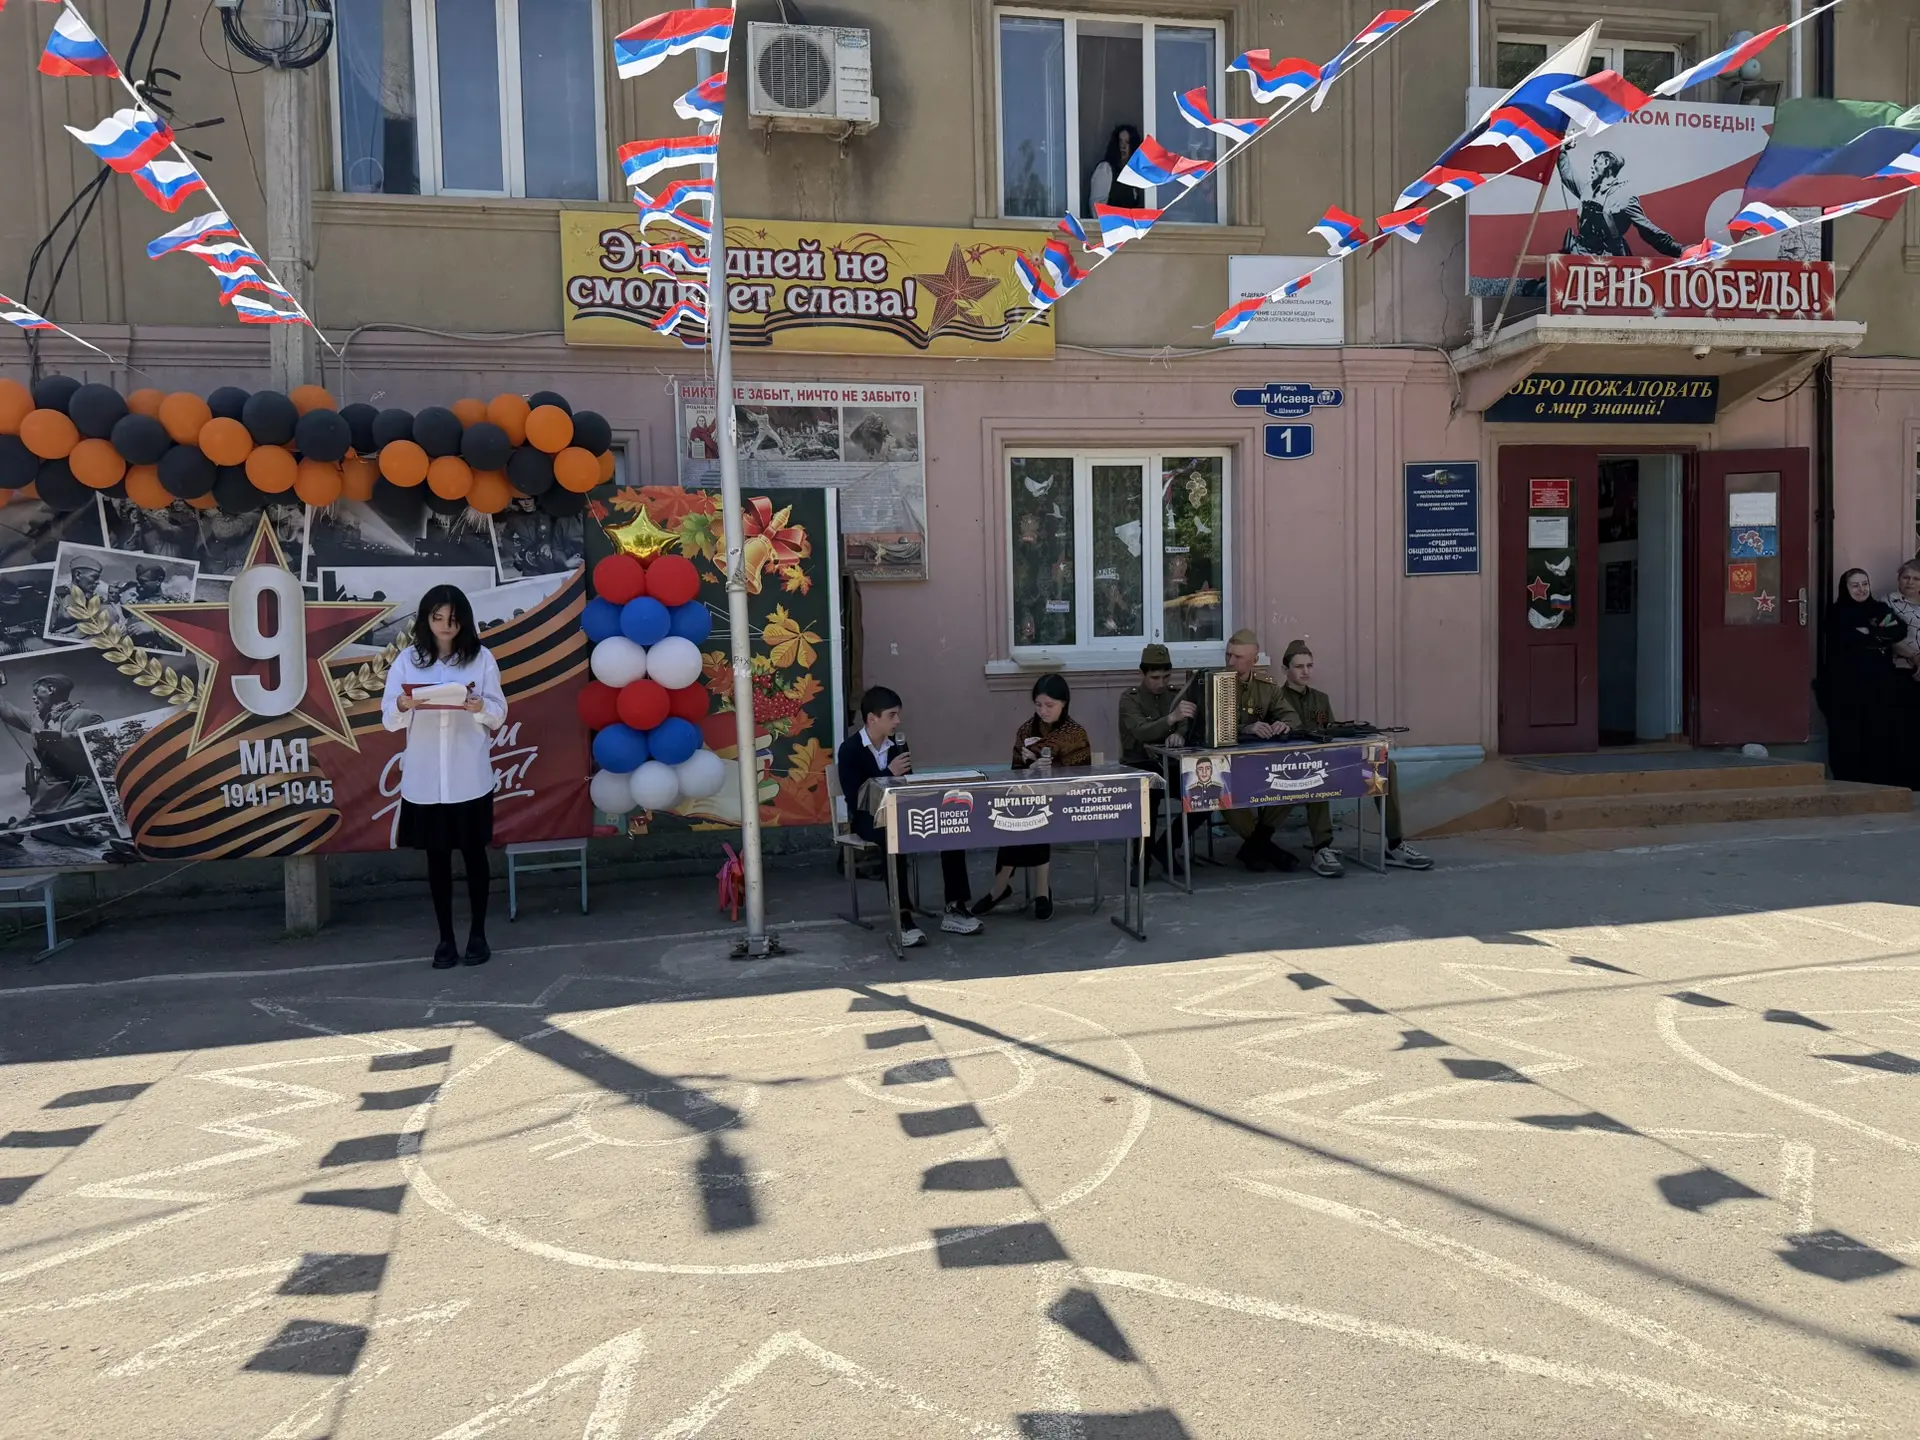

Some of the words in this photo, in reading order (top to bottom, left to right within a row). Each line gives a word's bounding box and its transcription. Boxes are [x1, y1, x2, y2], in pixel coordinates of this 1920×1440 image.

[1675, 112, 1755, 133] ПОБЕДЫ!
[725, 238, 824, 281] дней
[834, 248, 889, 283] не
[1561, 264, 1654, 310] ДЕНЬ
[1664, 268, 1821, 313] ПОБЕДЫ!
[567, 275, 775, 314] смолкет
[786, 275, 917, 318] слава!
[682, 386, 716, 398] НИКТ
[748, 388, 794, 403] ЗАБЫТ,
[797, 389, 838, 401] НИЧТО
[842, 390, 858, 402] НЕ
[861, 390, 911, 402] ЗАБЫТО
[1509, 379, 1565, 395] ОБРО
[1569, 379, 1713, 398] ПОЖАЛОВАТЬ
[1261, 393, 1314, 403] М.Исаева
[1535, 402, 1544, 414] в
[1548, 402, 1587, 418] мир
[1591, 399, 1665, 416] знаний!
[1280, 428, 1292, 453] 1
[1408, 546, 1477, 554] ОБЩЕОБРАЗОВАТЕЛЬНАЯ
[229, 564, 307, 716] 9
[239, 738, 309, 776] МАЯ
[1271, 763, 1297, 772] ПАРТА
[1298, 760, 1323, 770] ГЕРОЯ
[1066, 788, 1097, 796] «ПАРТА
[1098, 786, 1128, 794] ГЕРОЯ»
[1260, 794, 1281, 803] одной
[1282, 792, 1310, 801] партой
[1315, 789, 1342, 799] героем!
[994, 797, 1020, 808] ПАРТА
[1021, 794, 1047, 806] ГЕРОЯ
[1081, 796, 1112, 804] ПРОЕКТ
[940, 810, 969, 818] ПРОЕКТ
[1062, 802, 1133, 814] ОБЪЕДИНЯЮЩИЙ
[940, 818, 969, 826] НОВАЯ
[1071, 813, 1119, 822] ПОКОЛЕНИЯ
[940, 826, 971, 834] ШКОЛА
